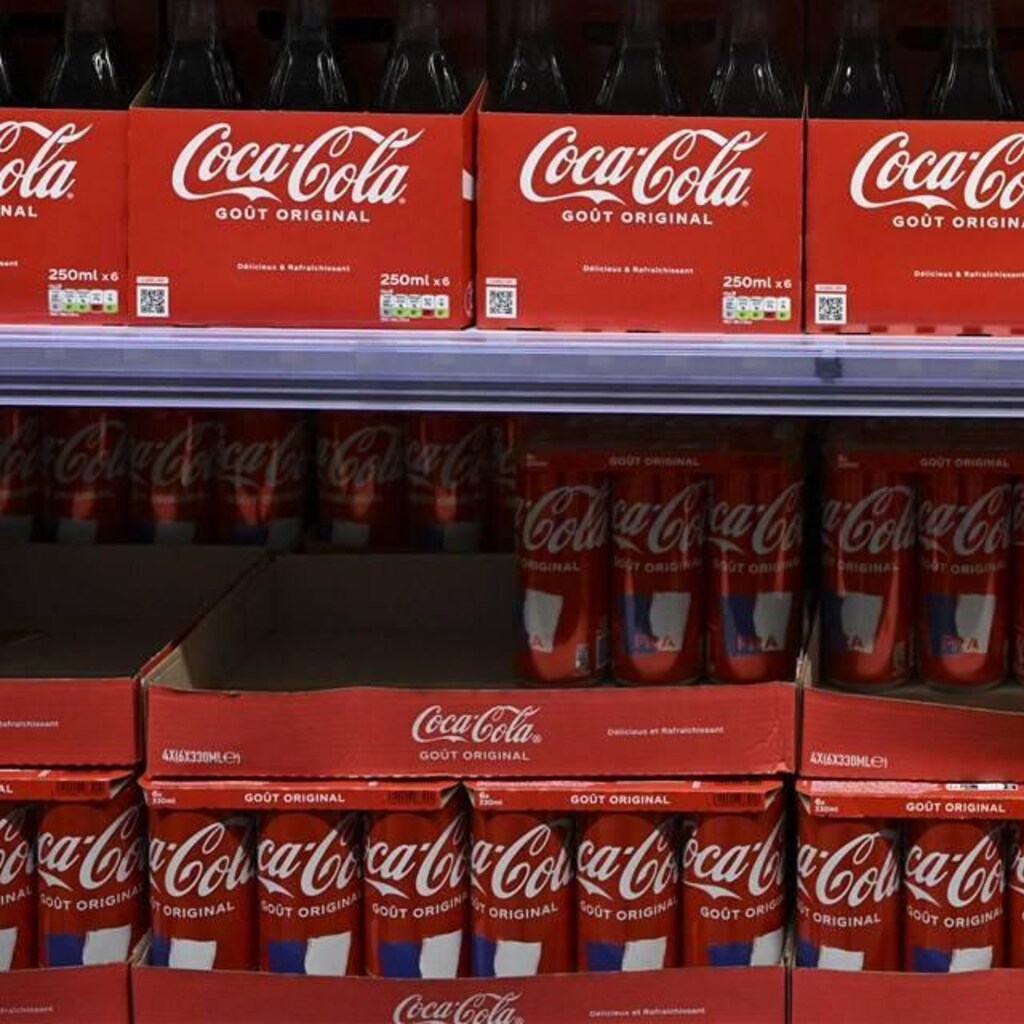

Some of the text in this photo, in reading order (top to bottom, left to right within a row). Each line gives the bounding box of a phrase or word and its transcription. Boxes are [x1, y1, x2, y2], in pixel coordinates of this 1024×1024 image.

[172, 122, 425, 205] Coca-Cola
[519, 126, 768, 207] Coca-Cola
[215, 205, 370, 223] GOÛT ORIGINAL
[562, 207, 713, 225] GOÛT ORIGINAL
[893, 212, 944, 228] GOÛT
[49, 268, 98, 282] 250ml
[380, 273, 430, 287] 250ml
[723, 276, 772, 289] 250ml
[412, 704, 542, 744] Coca-Cola
[420, 748, 530, 762] GOÛT ORIGINAL
[244, 790, 346, 804] GOÛT ORIGINAL
[571, 792, 671, 805] GOÛT ORIGINAL
[906, 800, 1006, 814] GOÛT ORIGINAL
[40, 893, 72, 912] GOÛT
[163, 901, 236, 919] ORIGINAL
[261, 900, 292, 918] GOÛT
[372, 902, 407, 919] GOÛT
[579, 899, 610, 921] GOÛT
[489, 903, 558, 920] ORIGINAL
[700, 905, 740, 921] GOÛT
[813, 912, 881, 927] ORIGINAL
[907, 905, 938, 926] GOÛT
